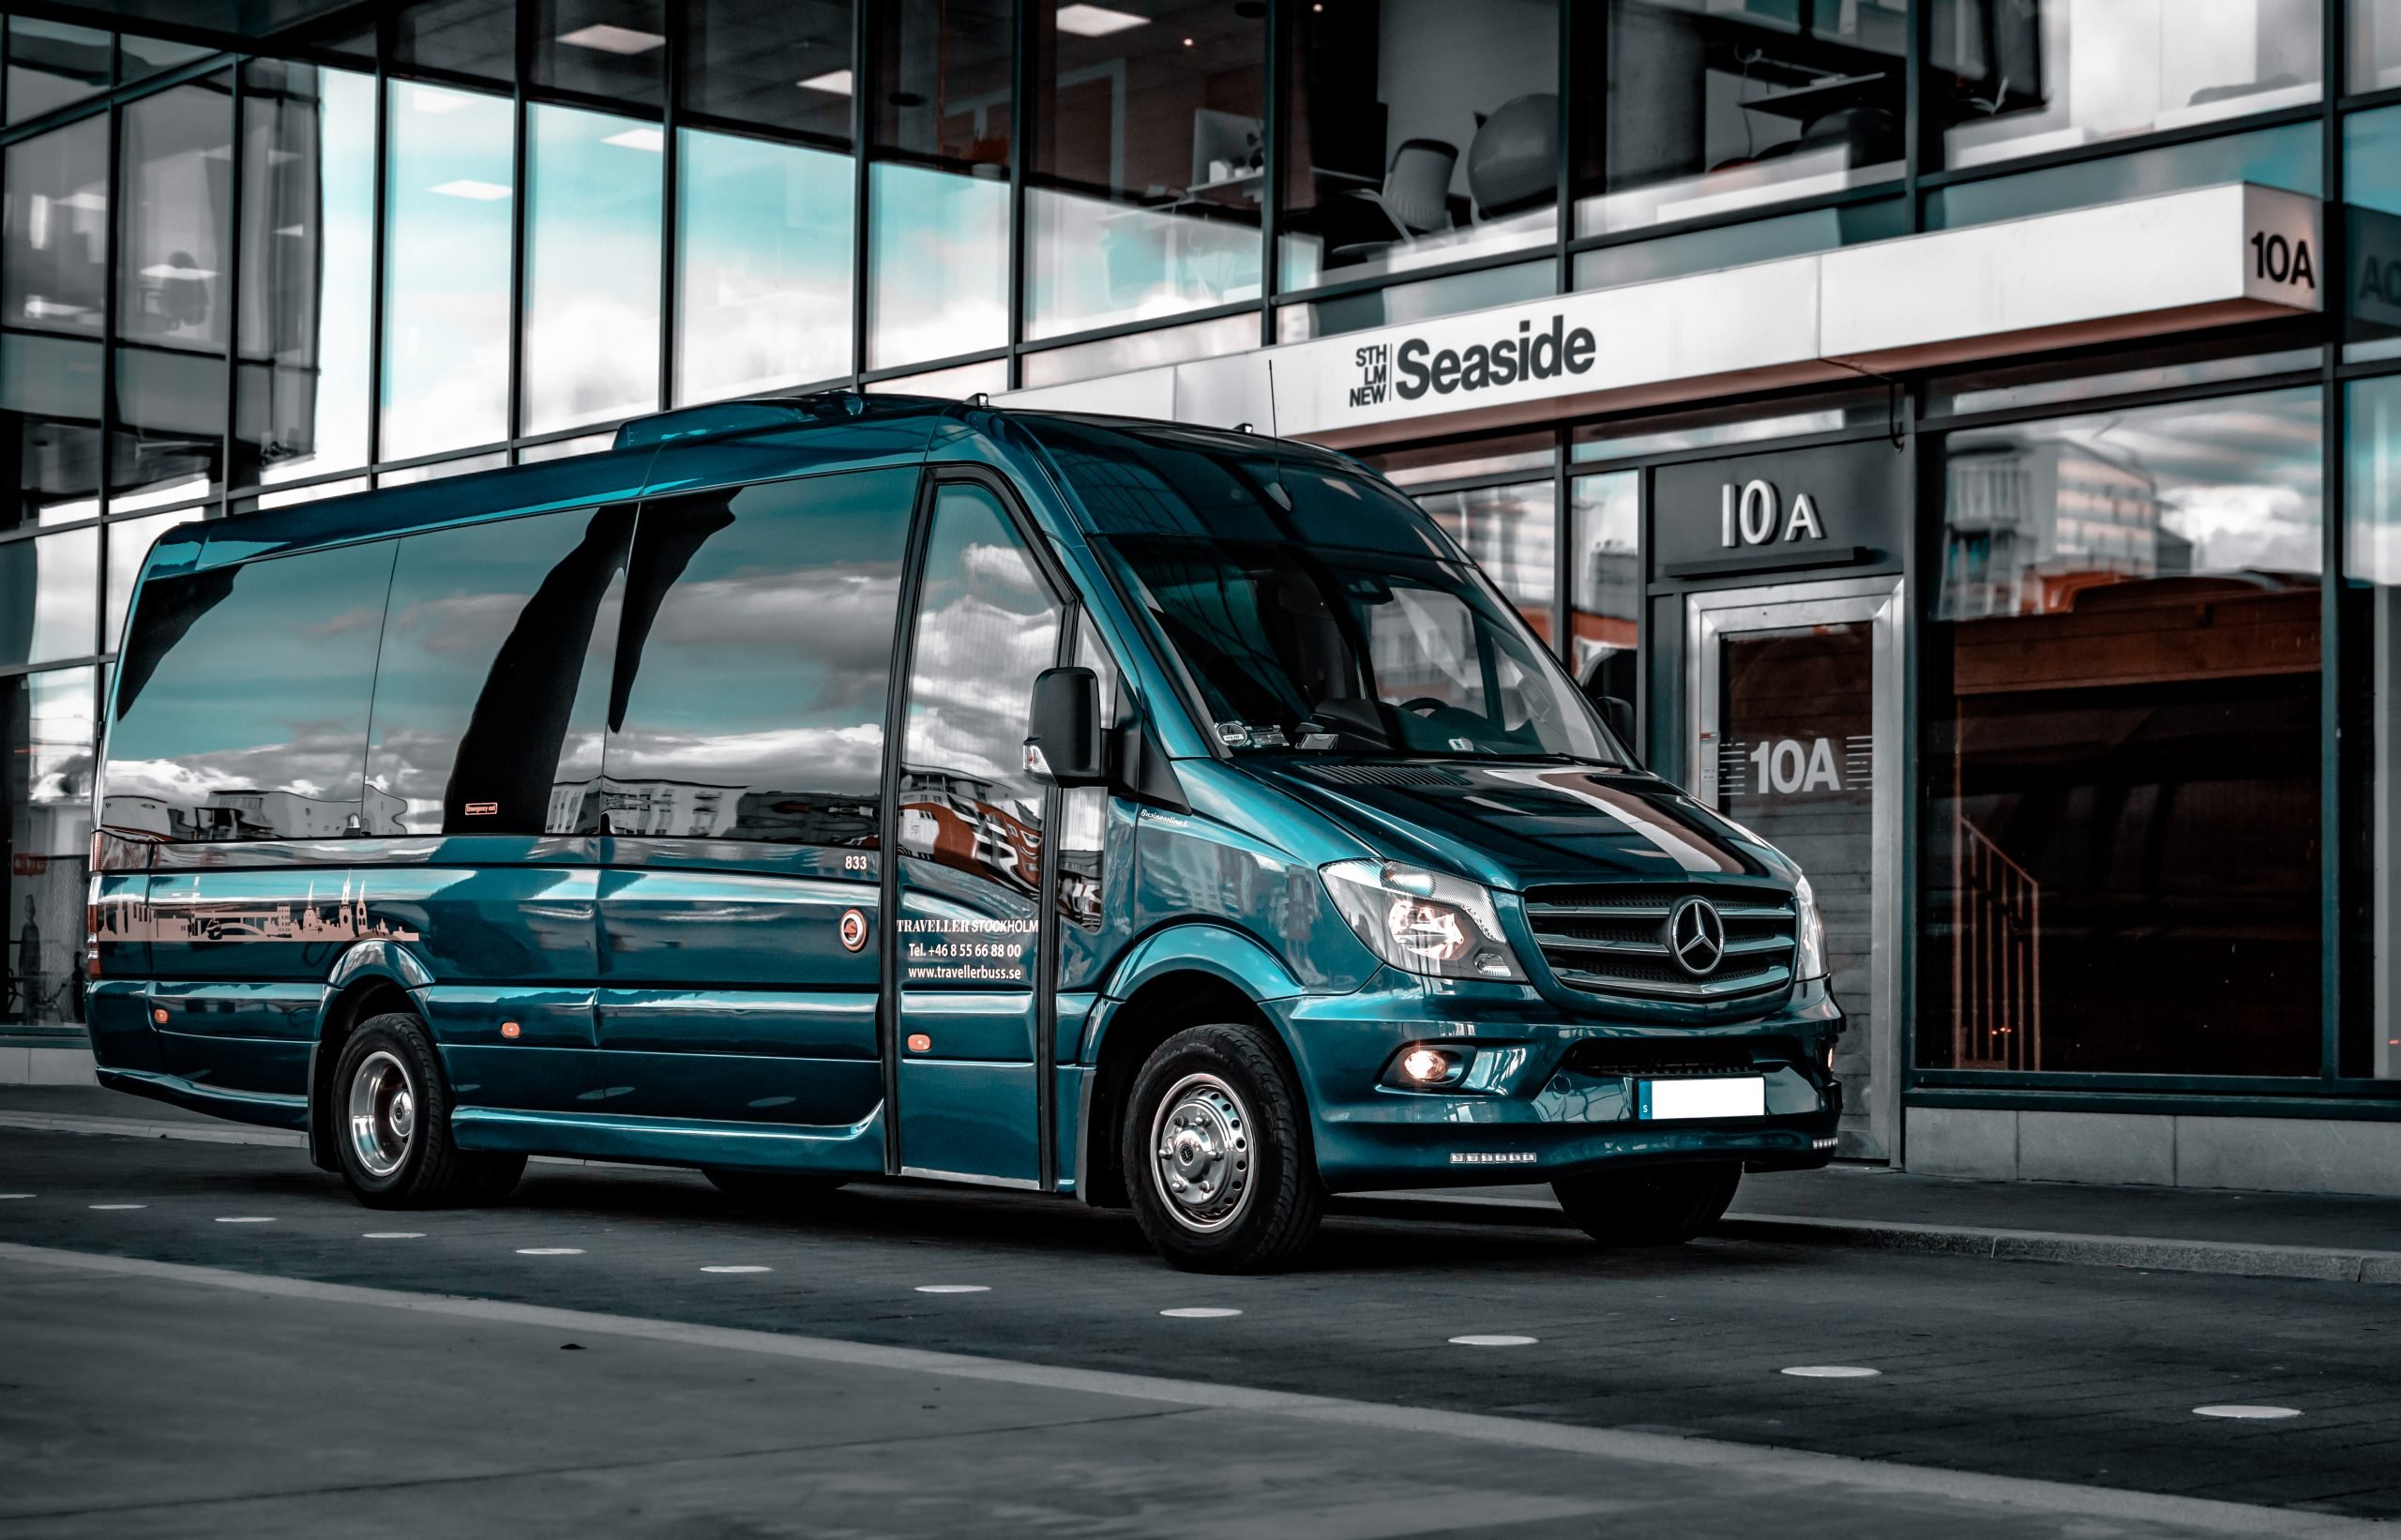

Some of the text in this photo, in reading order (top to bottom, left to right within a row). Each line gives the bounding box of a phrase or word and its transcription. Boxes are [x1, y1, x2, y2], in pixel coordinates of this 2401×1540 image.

[2250, 231, 2317, 289] 10A
[1355, 343, 1387, 368] STH
[1395, 314, 1596, 400] Seaside
[1364, 364, 1387, 386] LM
[1349, 383, 1387, 408] NEW
[1750, 737, 1841, 794] 10A
[845, 855, 868, 870] 833
[897, 919, 1039, 933] TRAVELLER STOCKHOLM
[908, 943, 1021, 958] Tel. +46 8 55 66 88 00
[908, 964, 1021, 979] www.travellerbuss.se
[1642, 1104, 1648, 1113] S
